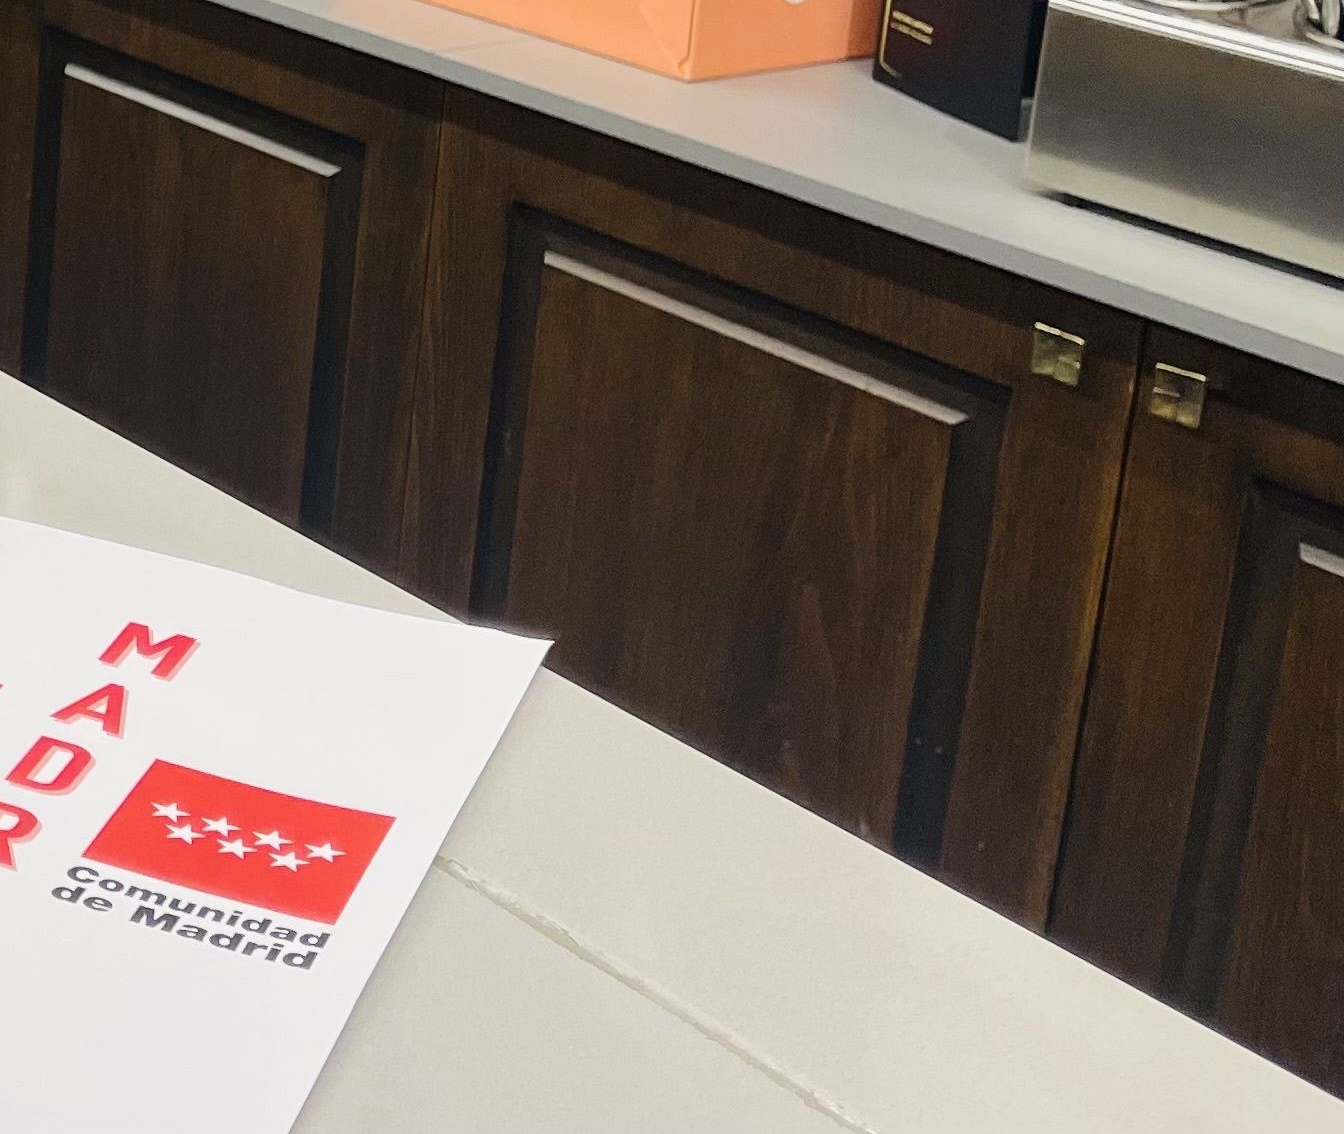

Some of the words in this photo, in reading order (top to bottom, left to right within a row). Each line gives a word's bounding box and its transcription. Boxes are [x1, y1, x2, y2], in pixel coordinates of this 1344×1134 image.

[51, 885, 114, 912] de
[129, 905, 319, 971] Madrid
[66, 865, 332, 949] Comunidad
